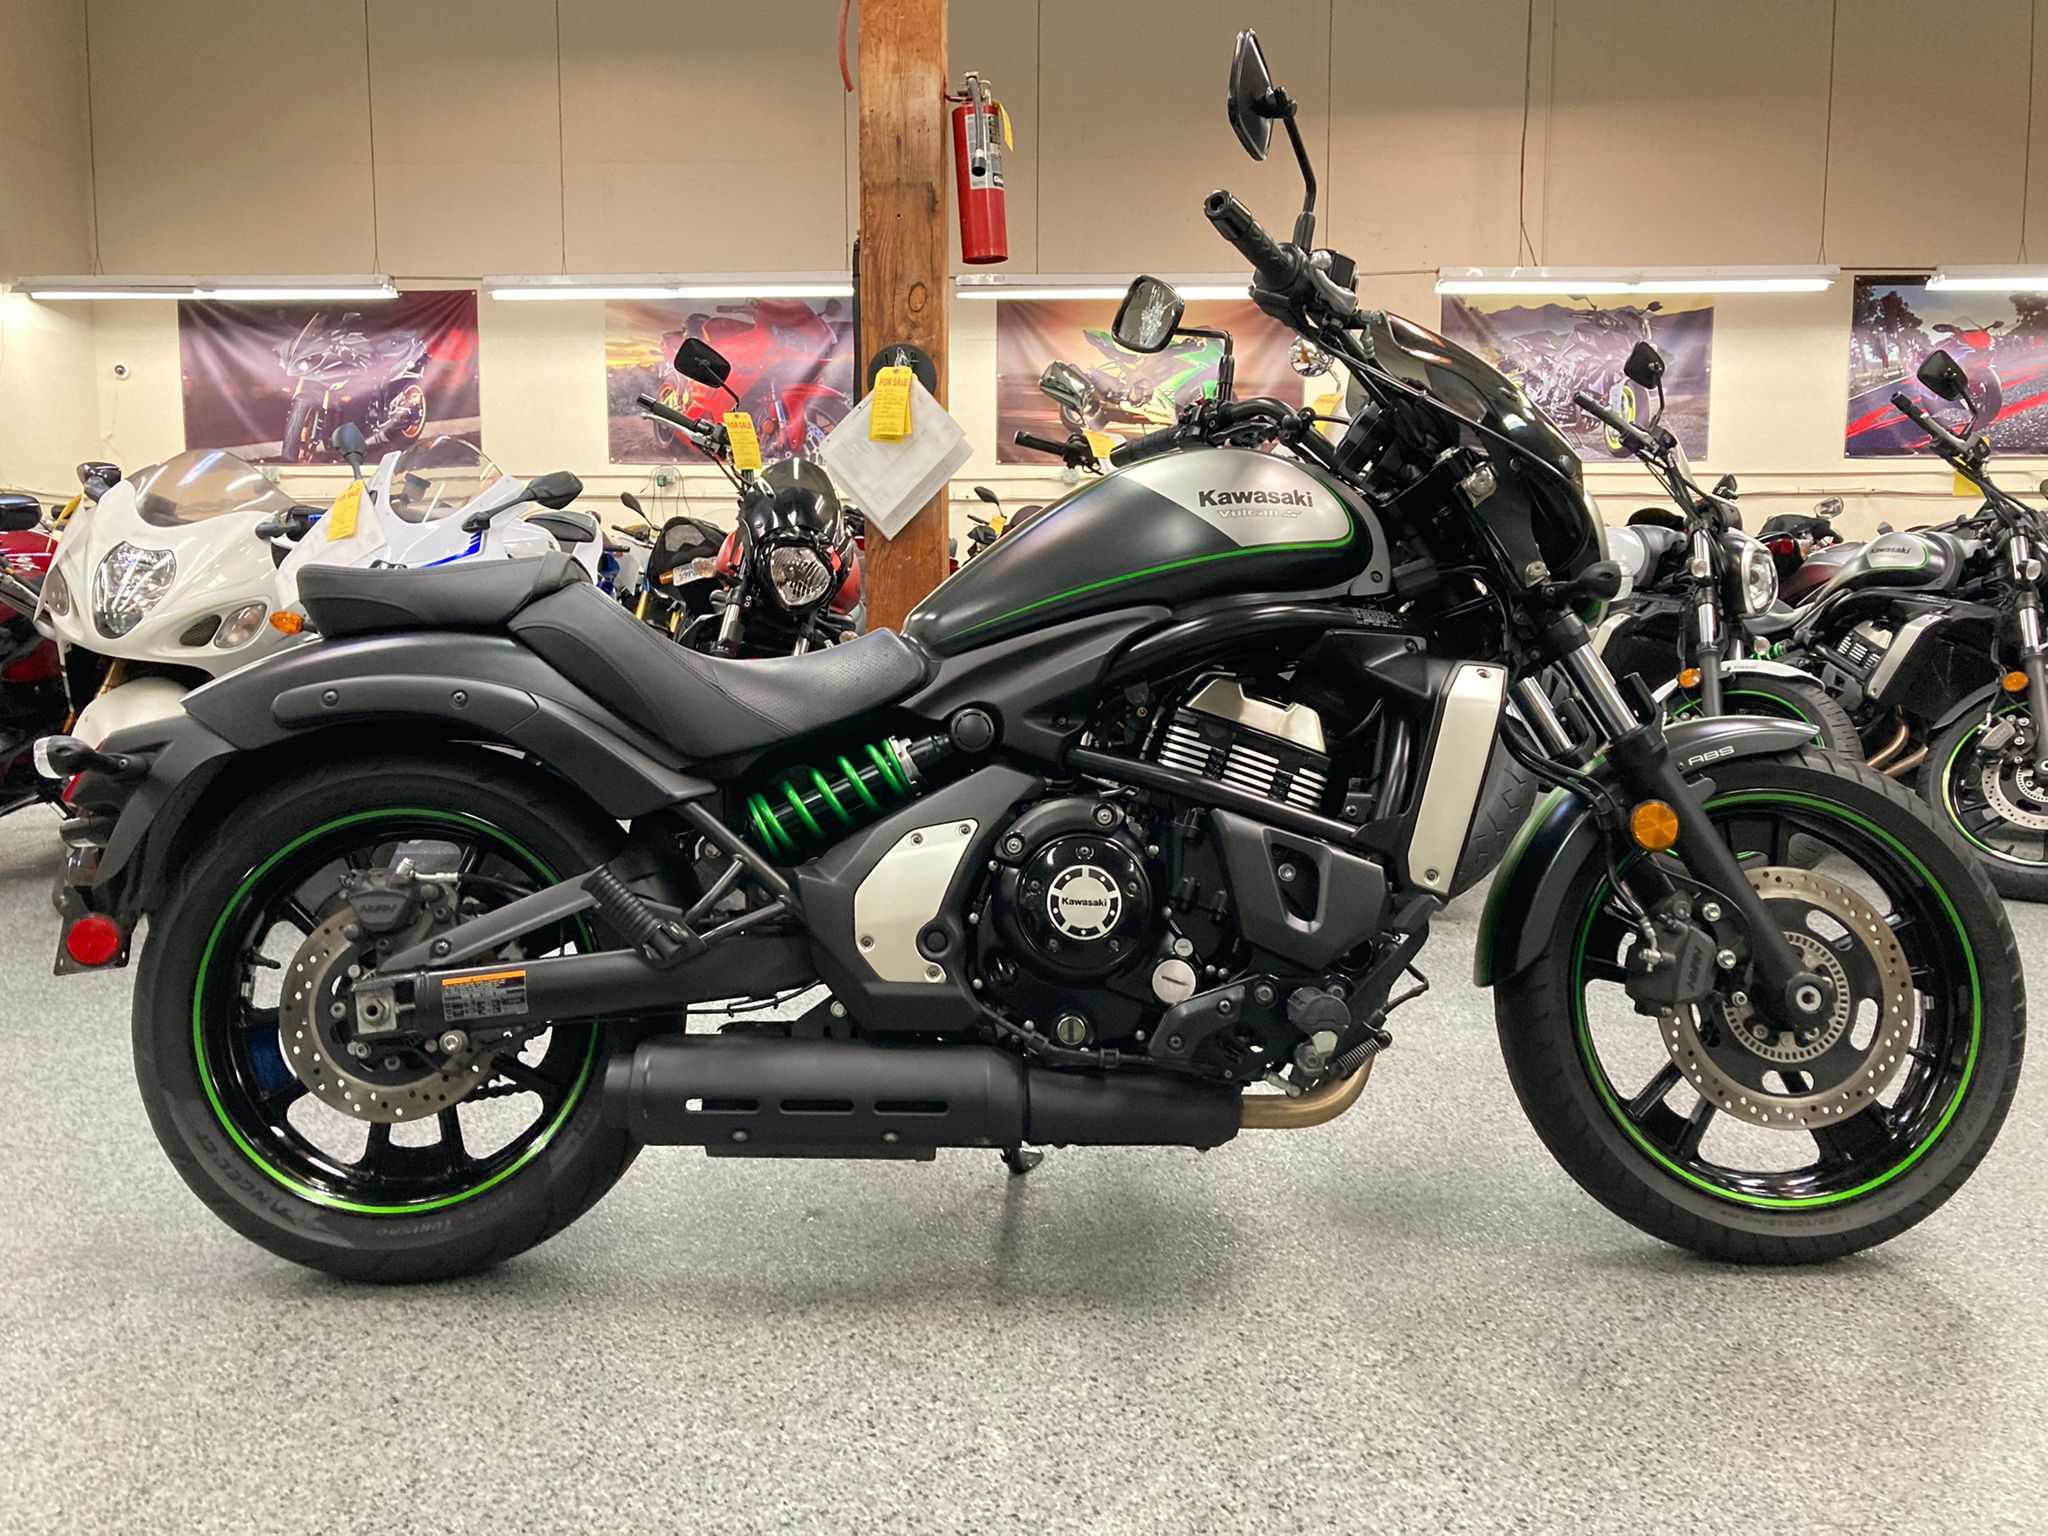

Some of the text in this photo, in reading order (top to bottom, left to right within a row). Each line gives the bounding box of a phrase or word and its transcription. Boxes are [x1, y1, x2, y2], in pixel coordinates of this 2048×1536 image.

[879, 377, 909, 387] FOR SALE
[1198, 489, 1313, 508] Kawasaki
[1217, 507, 1279, 519] Vulcan
[1687, 745, 1735, 766] ABS
[1061, 897, 1107, 907] Kawasaki
